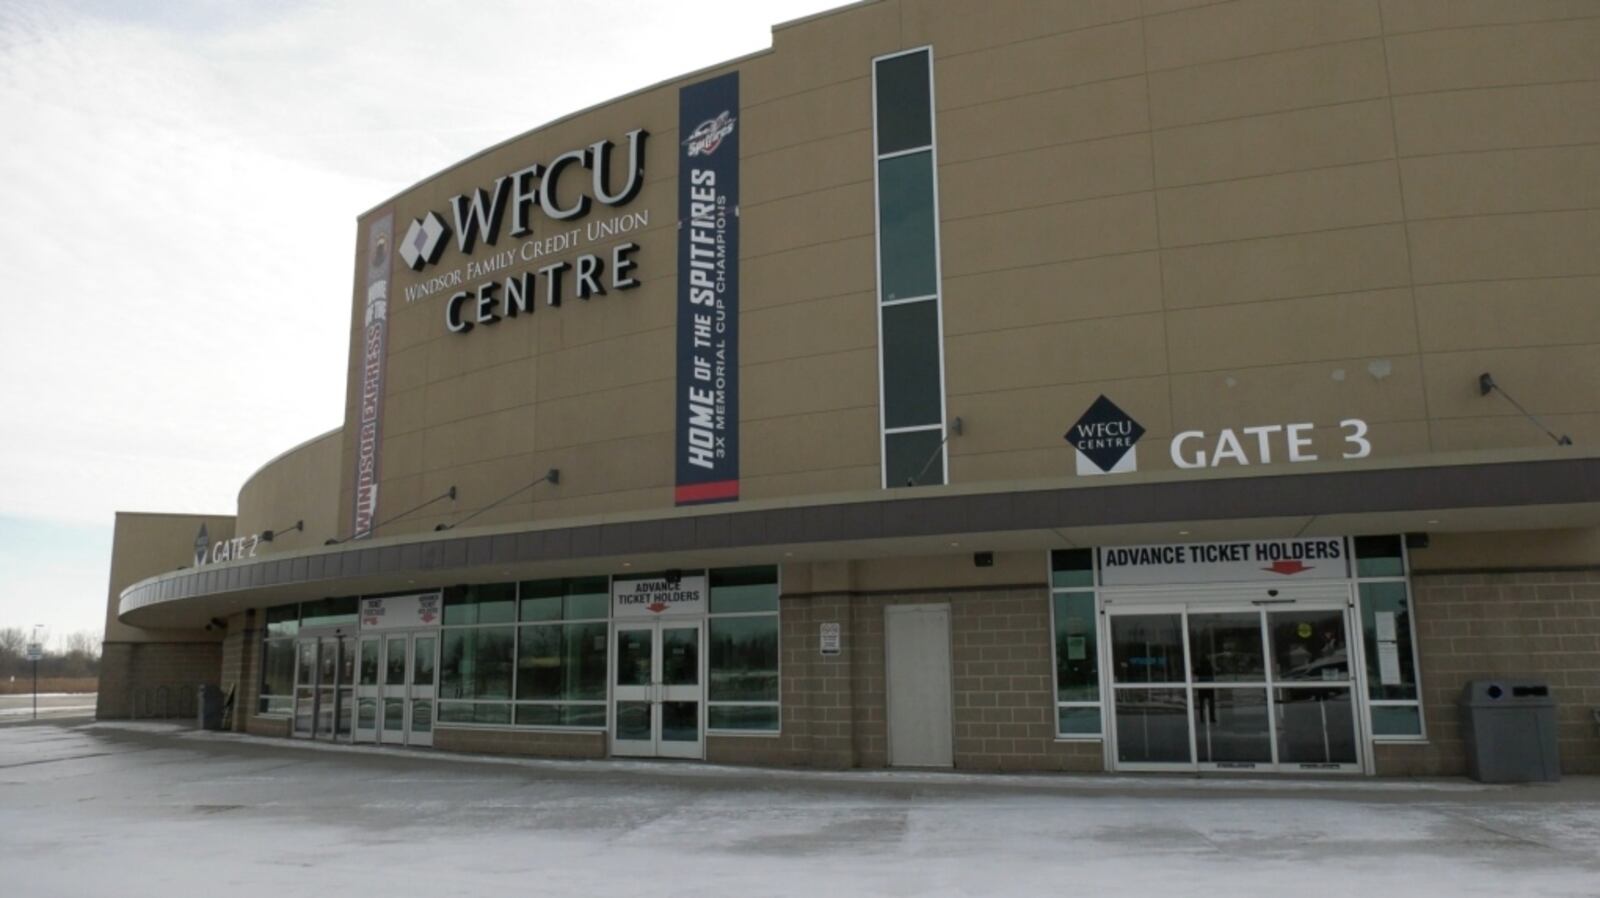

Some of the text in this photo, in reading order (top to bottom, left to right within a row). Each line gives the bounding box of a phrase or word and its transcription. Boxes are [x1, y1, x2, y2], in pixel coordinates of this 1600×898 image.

[449, 128, 646, 253] WFCU
[404, 269, 462, 303] WINDSOR
[466, 249, 517, 281] FAMILY
[521, 229, 581, 261] CREDIT
[587, 210, 649, 242] UNION
[446, 242, 638, 333] CENTRE
[688, 168, 715, 469] HOME OF THE SPITFIRES
[716, 195, 726, 458] 3X MEMORIAL CUP CHAMPIONS
[362, 321, 382, 423] EXPRESS
[1077, 420, 1132, 438] WFCU
[1078, 436, 1132, 450] CENTRE
[1170, 417, 1372, 469] GATE 3
[212, 533, 259, 563] GATE 2
[1105, 539, 1341, 567] ADVANCE TICKET HOLDERS
[618, 590, 700, 604] TICKET HOLDERS
[635, 581, 681, 593] ADVANCE
